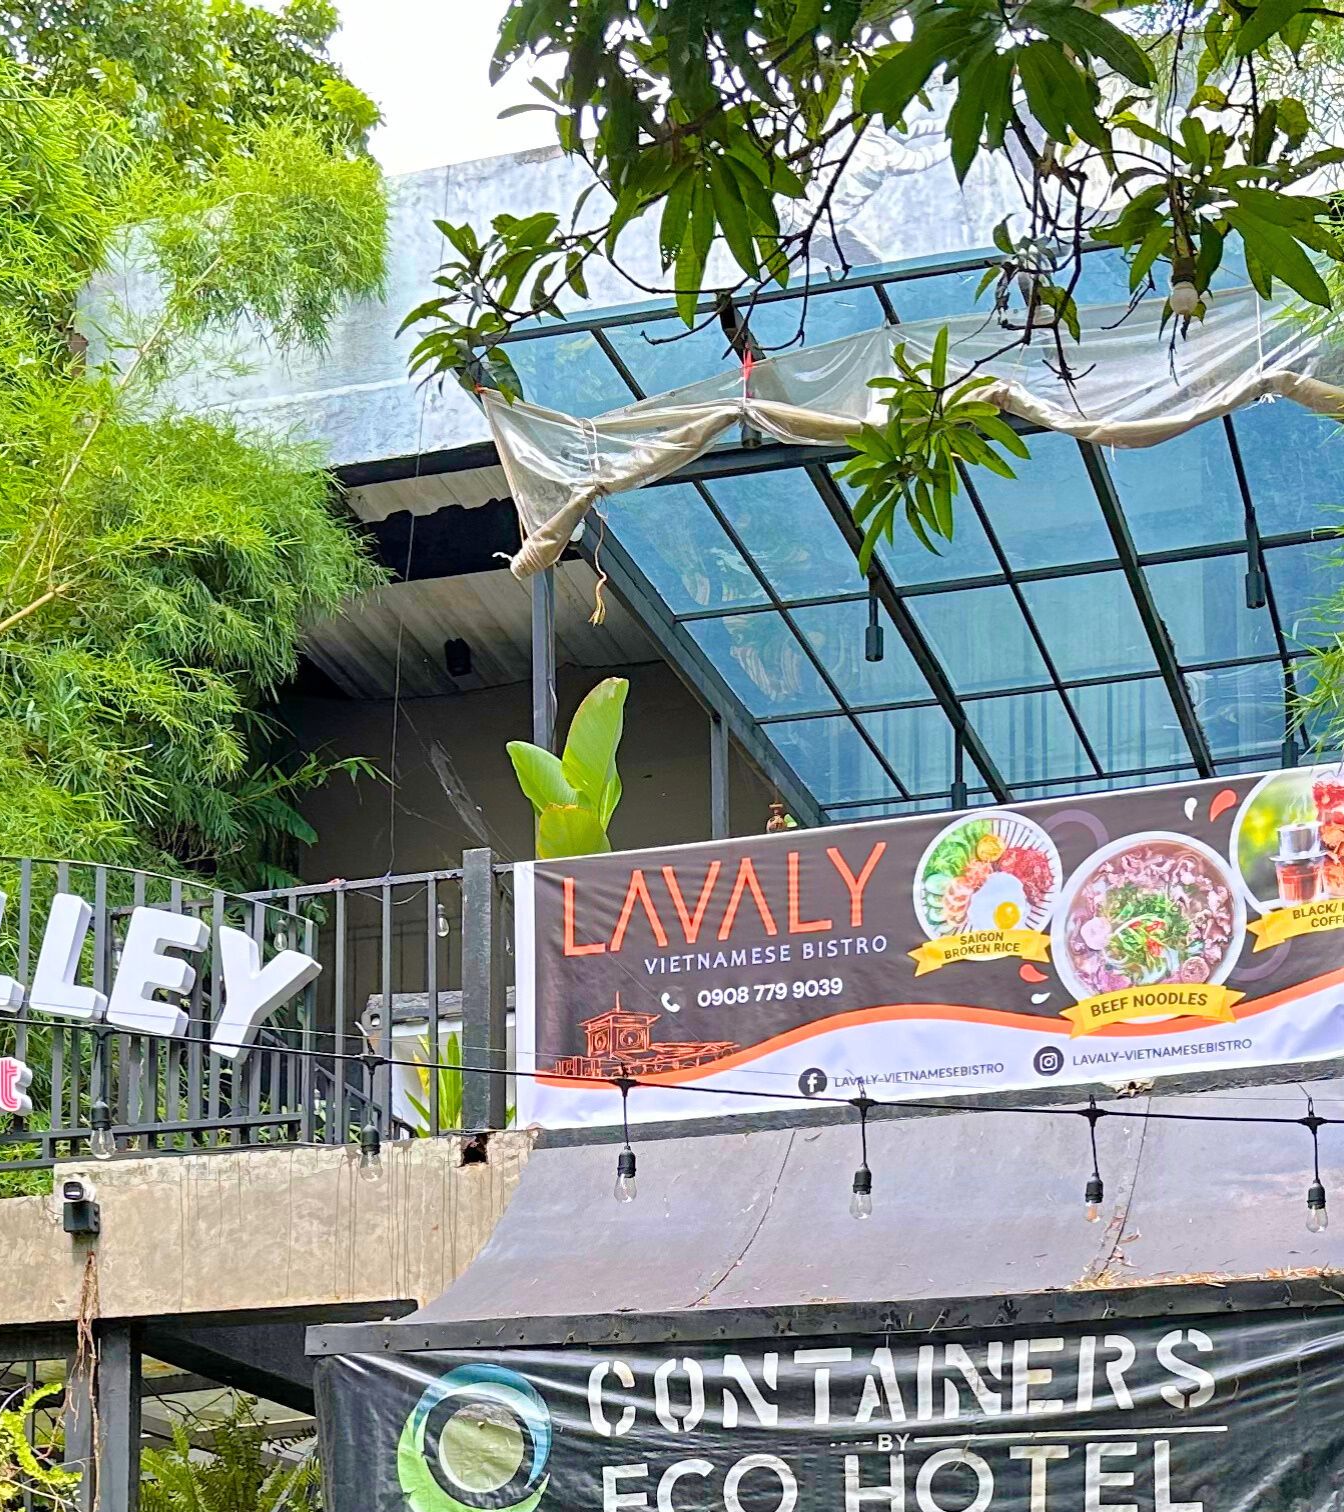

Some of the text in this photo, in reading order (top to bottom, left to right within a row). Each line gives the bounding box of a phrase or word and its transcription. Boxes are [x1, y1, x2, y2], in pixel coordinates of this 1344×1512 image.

[563, 842, 886, 956] LAVALY
[944, 942, 1020, 960] BROKEN RICE
[959, 931, 1004, 946] SAIGON
[644, 935, 888, 975] VIETNAMESE BISTRO
[697, 978, 843, 1008] 0908 779 9039
[1091, 992, 1208, 1017] BEEF NOODLES
[1072, 1038, 1253, 1066] LAVALY-VIETNAMESEBISTRO
[587, 1328, 1216, 1436] CONTAINERS
[877, 1433, 910, 1452] BY
